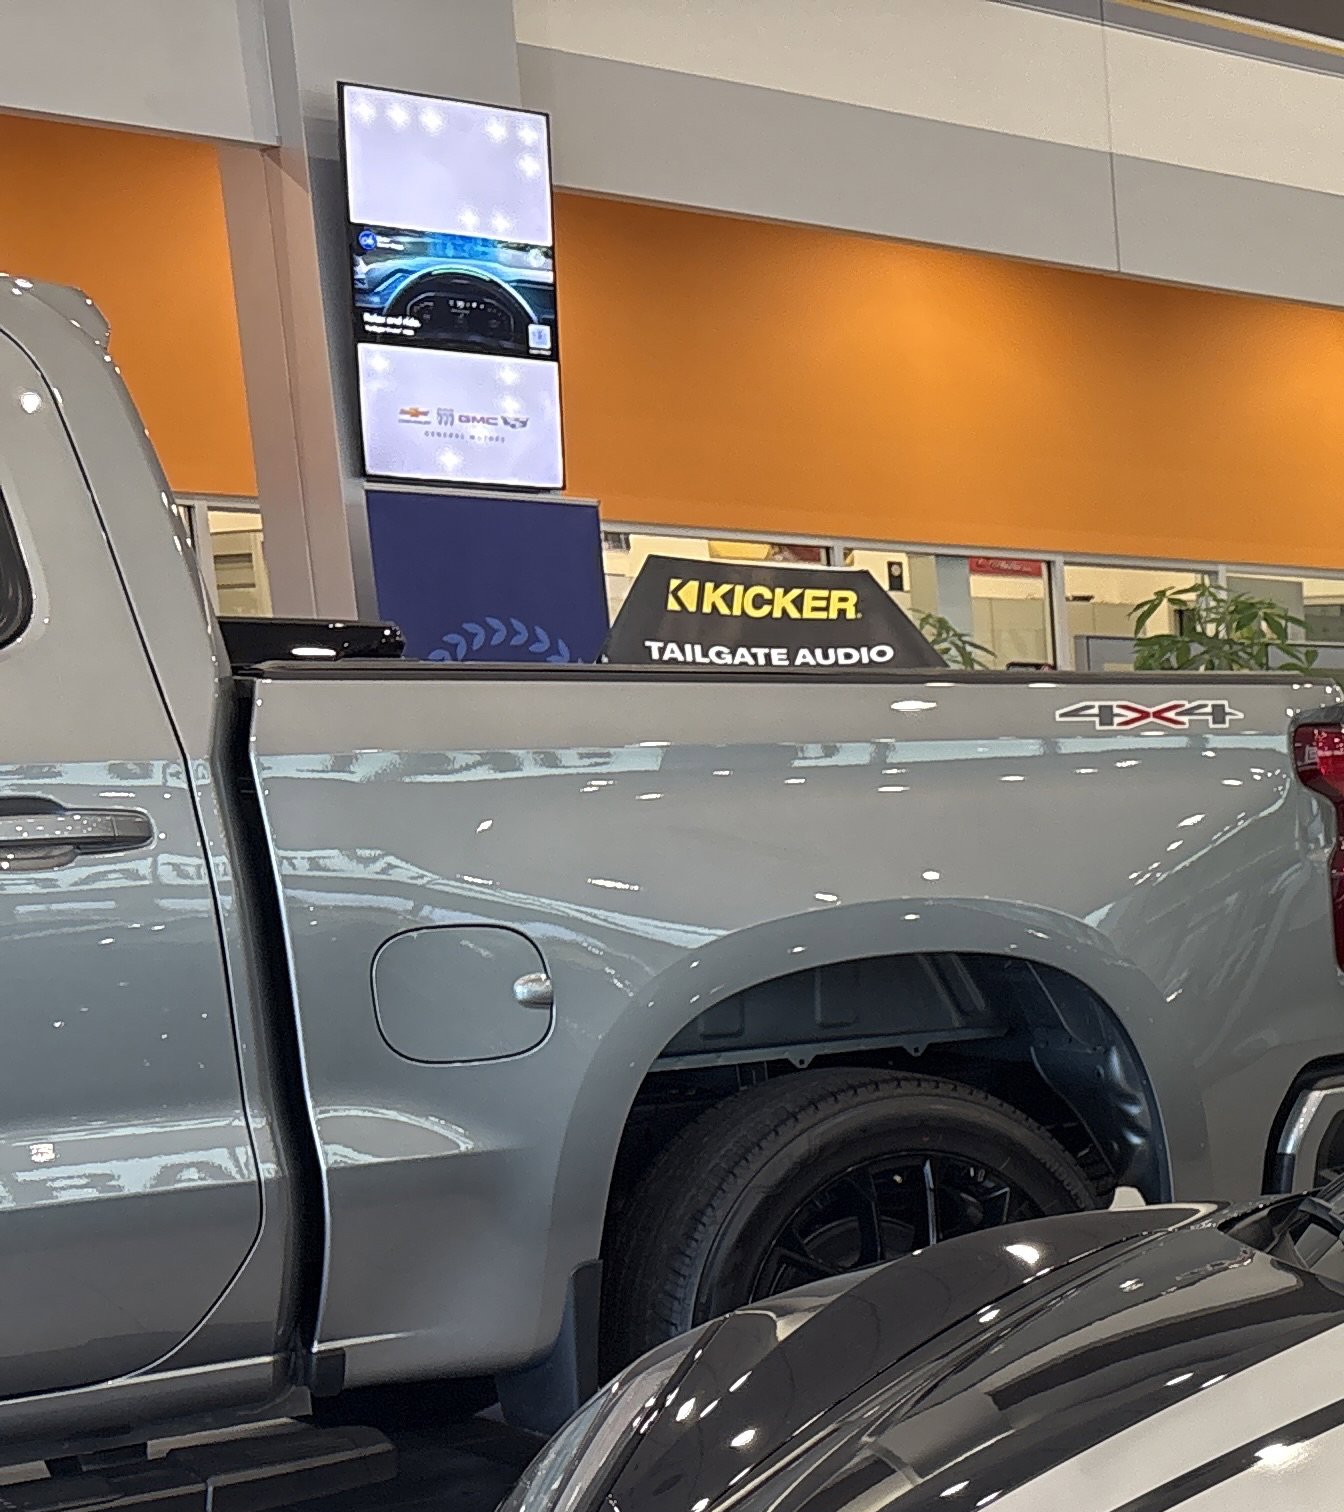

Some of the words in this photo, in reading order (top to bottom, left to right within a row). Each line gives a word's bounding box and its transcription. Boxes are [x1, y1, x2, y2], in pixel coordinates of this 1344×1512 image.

[458, 414, 498, 426] GMC
[702, 582, 858, 620] KICKER
[644, 640, 790, 666] TAILGATE
[793, 644, 895, 666] AUDIO
